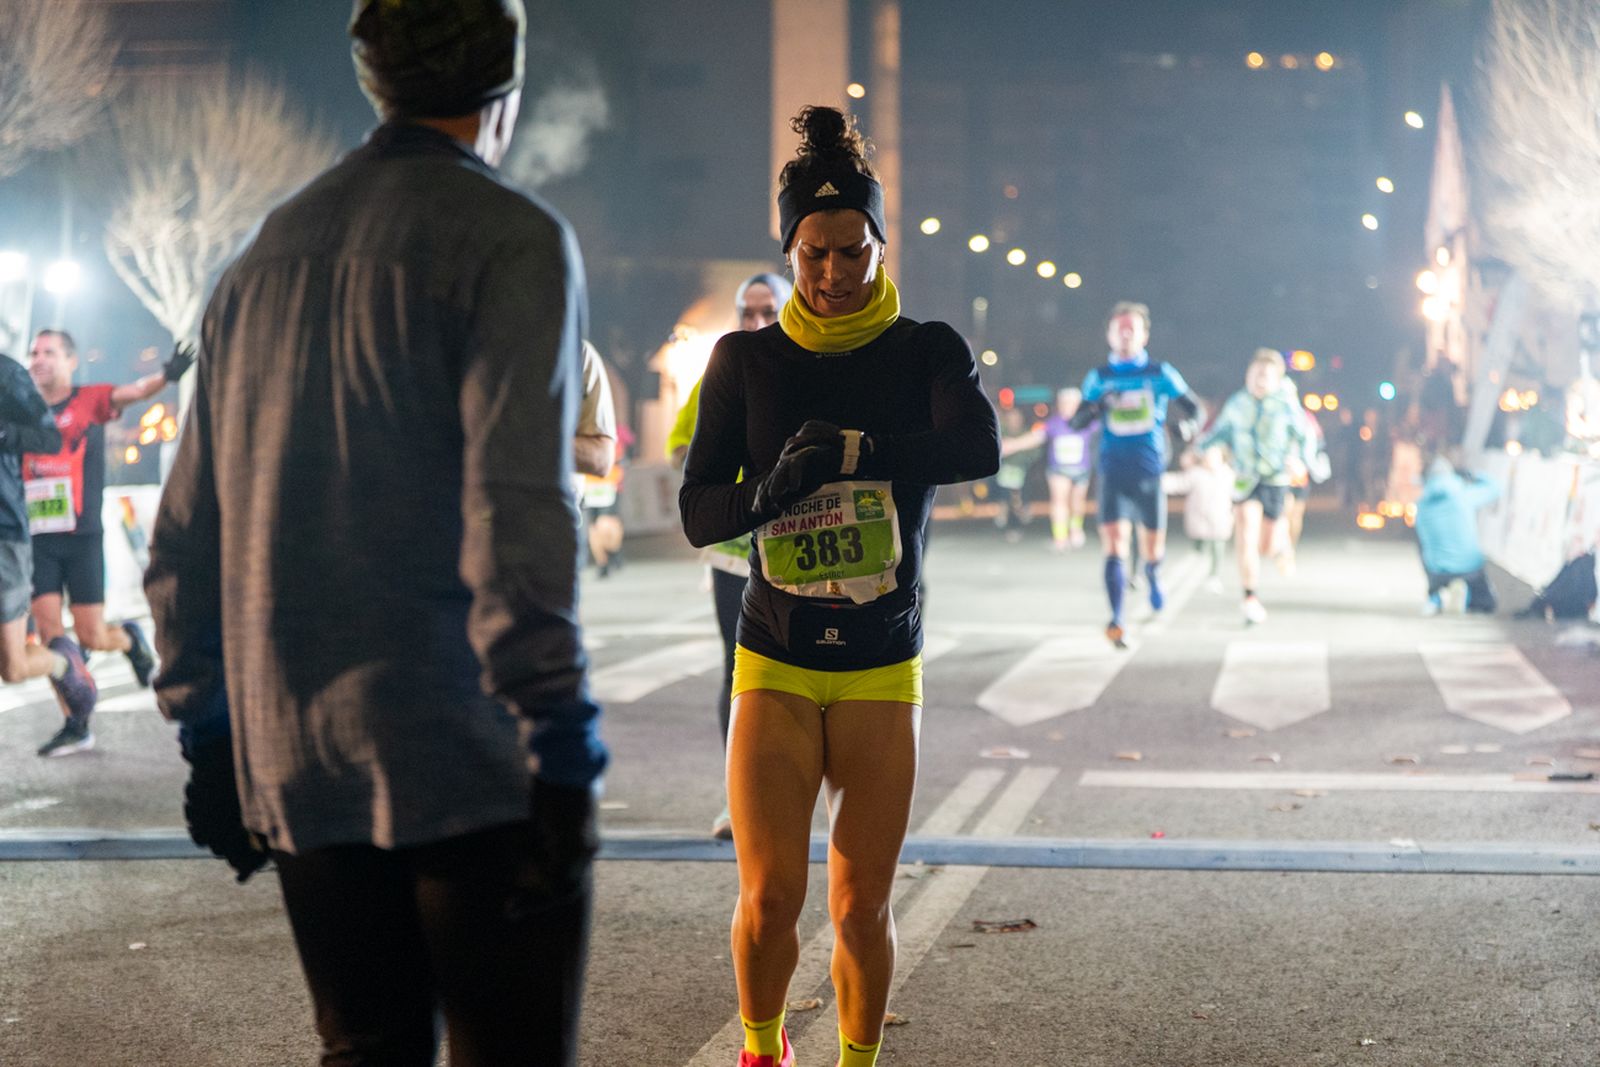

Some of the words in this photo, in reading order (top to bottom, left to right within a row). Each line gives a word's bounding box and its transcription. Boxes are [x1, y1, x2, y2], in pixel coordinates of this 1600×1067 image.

[826, 497, 841, 510] DE
[771, 520, 796, 536] SAN
[800, 510, 843, 530] ANTÓN
[794, 527, 864, 571] 383
